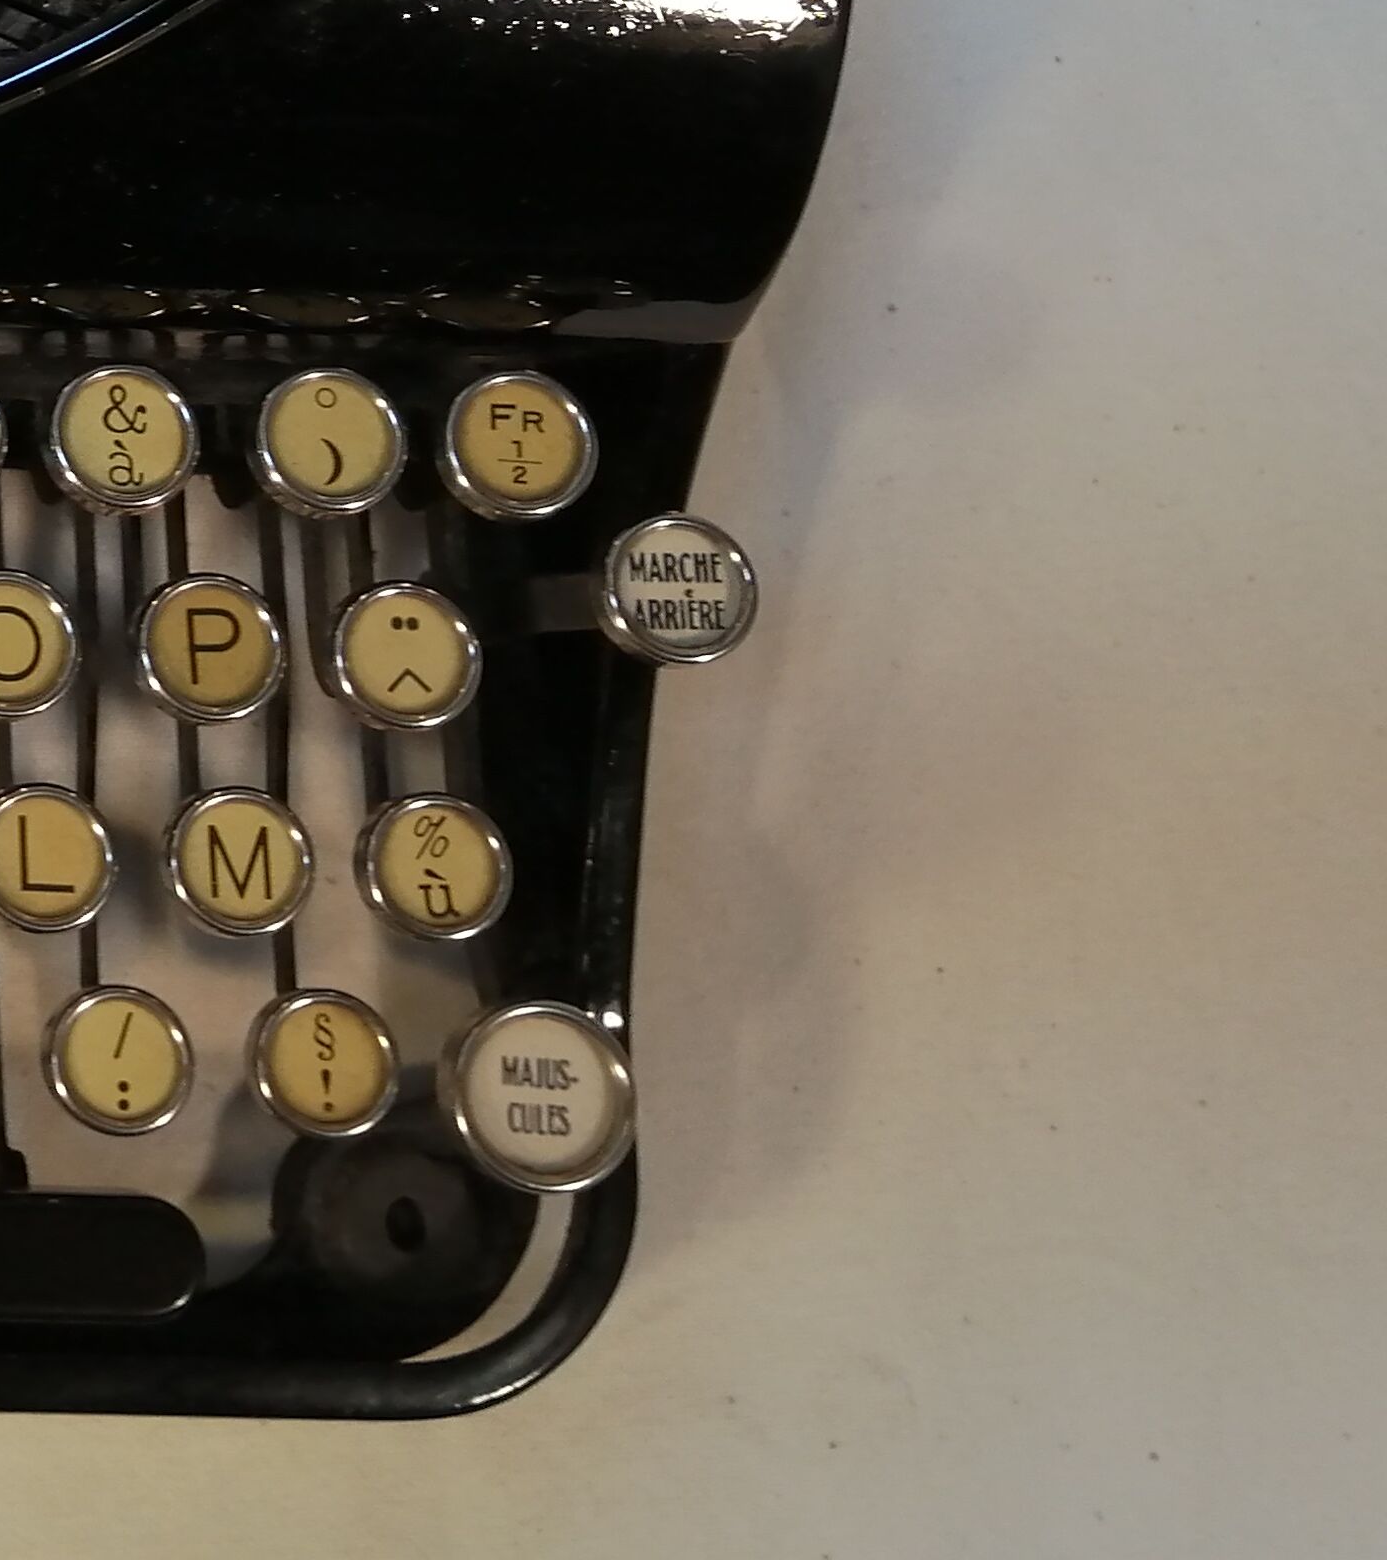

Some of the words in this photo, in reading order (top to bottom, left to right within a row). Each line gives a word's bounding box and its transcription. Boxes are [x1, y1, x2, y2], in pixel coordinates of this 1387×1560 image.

[102, 384, 147, 435] &
[109, 442, 143, 487] à
[629, 552, 722, 582] MARCHE
[186, 607, 241, 685] P
[18, 815, 75, 894] L
[207, 824, 272, 900] M
[420, 868, 460, 919] ù
[501, 1055, 579, 1087] MAJUS-
[508, 1103, 570, 1136] CULES
